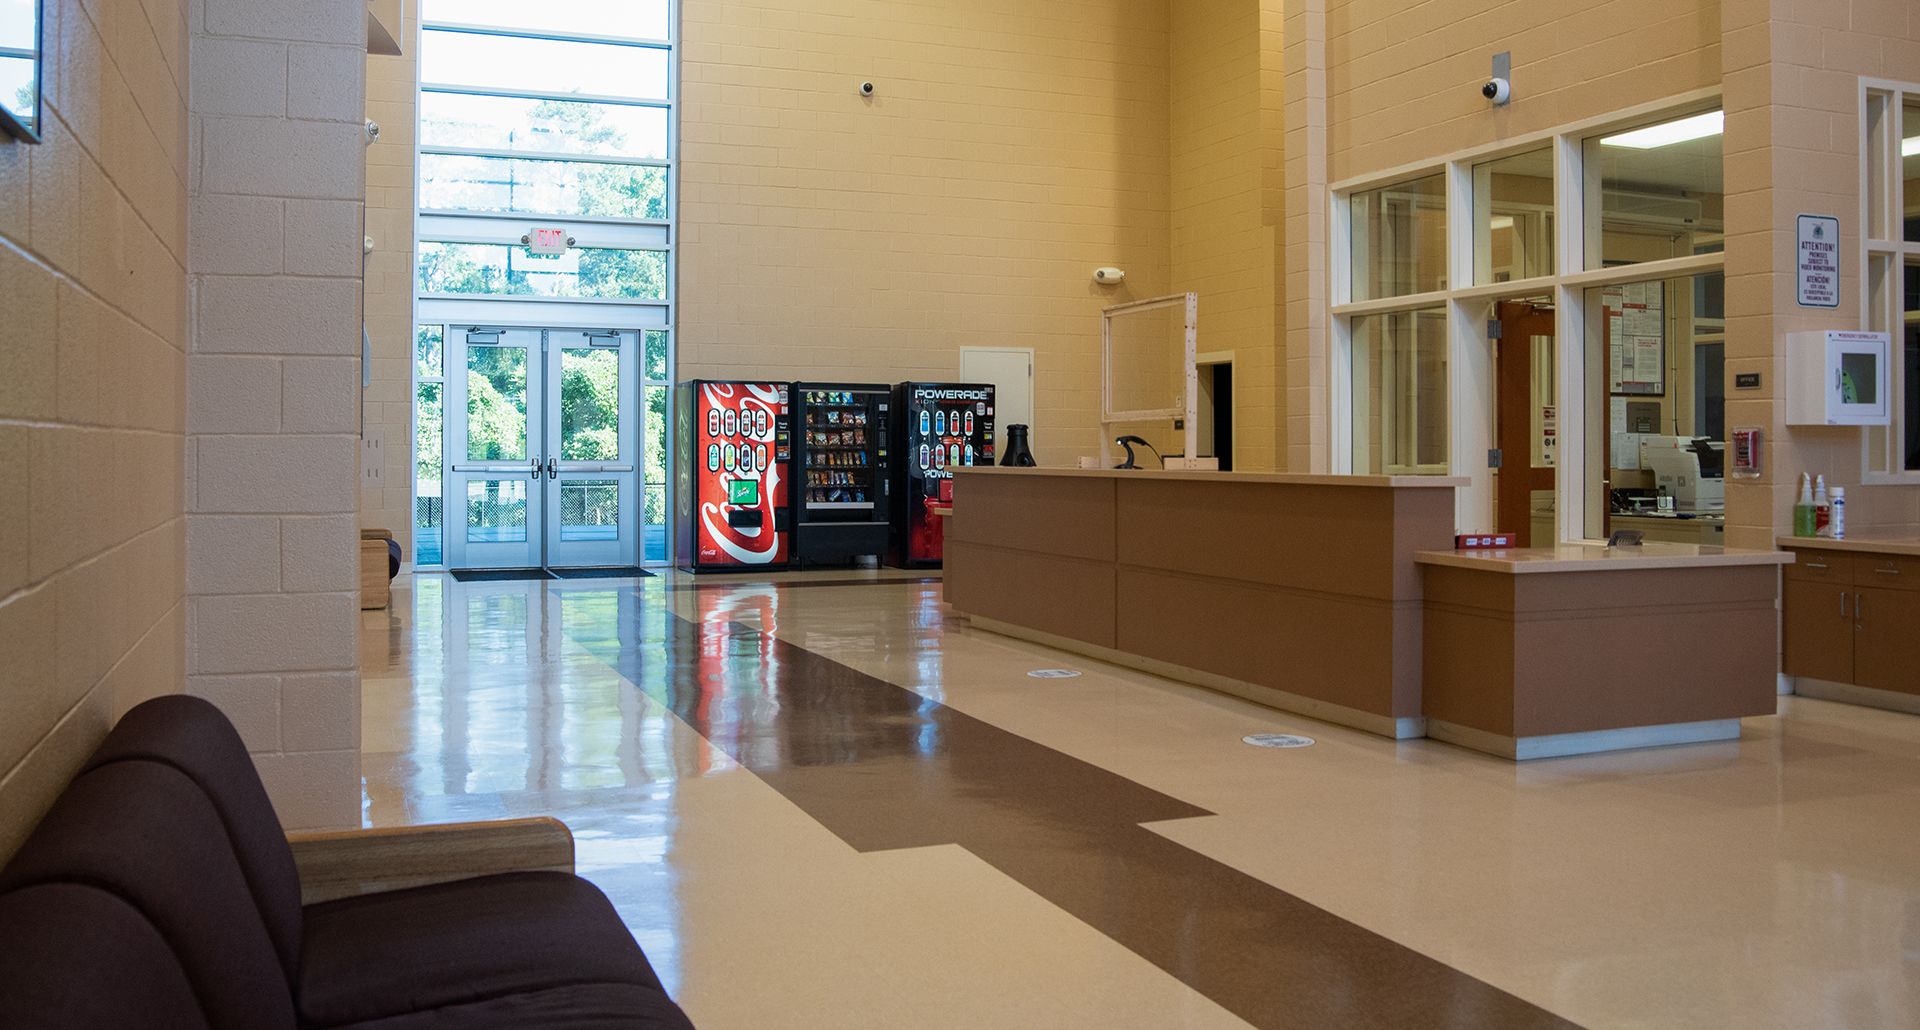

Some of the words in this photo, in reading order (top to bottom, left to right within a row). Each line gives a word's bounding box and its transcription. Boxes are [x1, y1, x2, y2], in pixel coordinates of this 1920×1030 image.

[536, 229, 561, 247] EXIT
[1801, 241, 1835, 252] ATTENTION!
[914, 389, 987, 400] POWERADE
